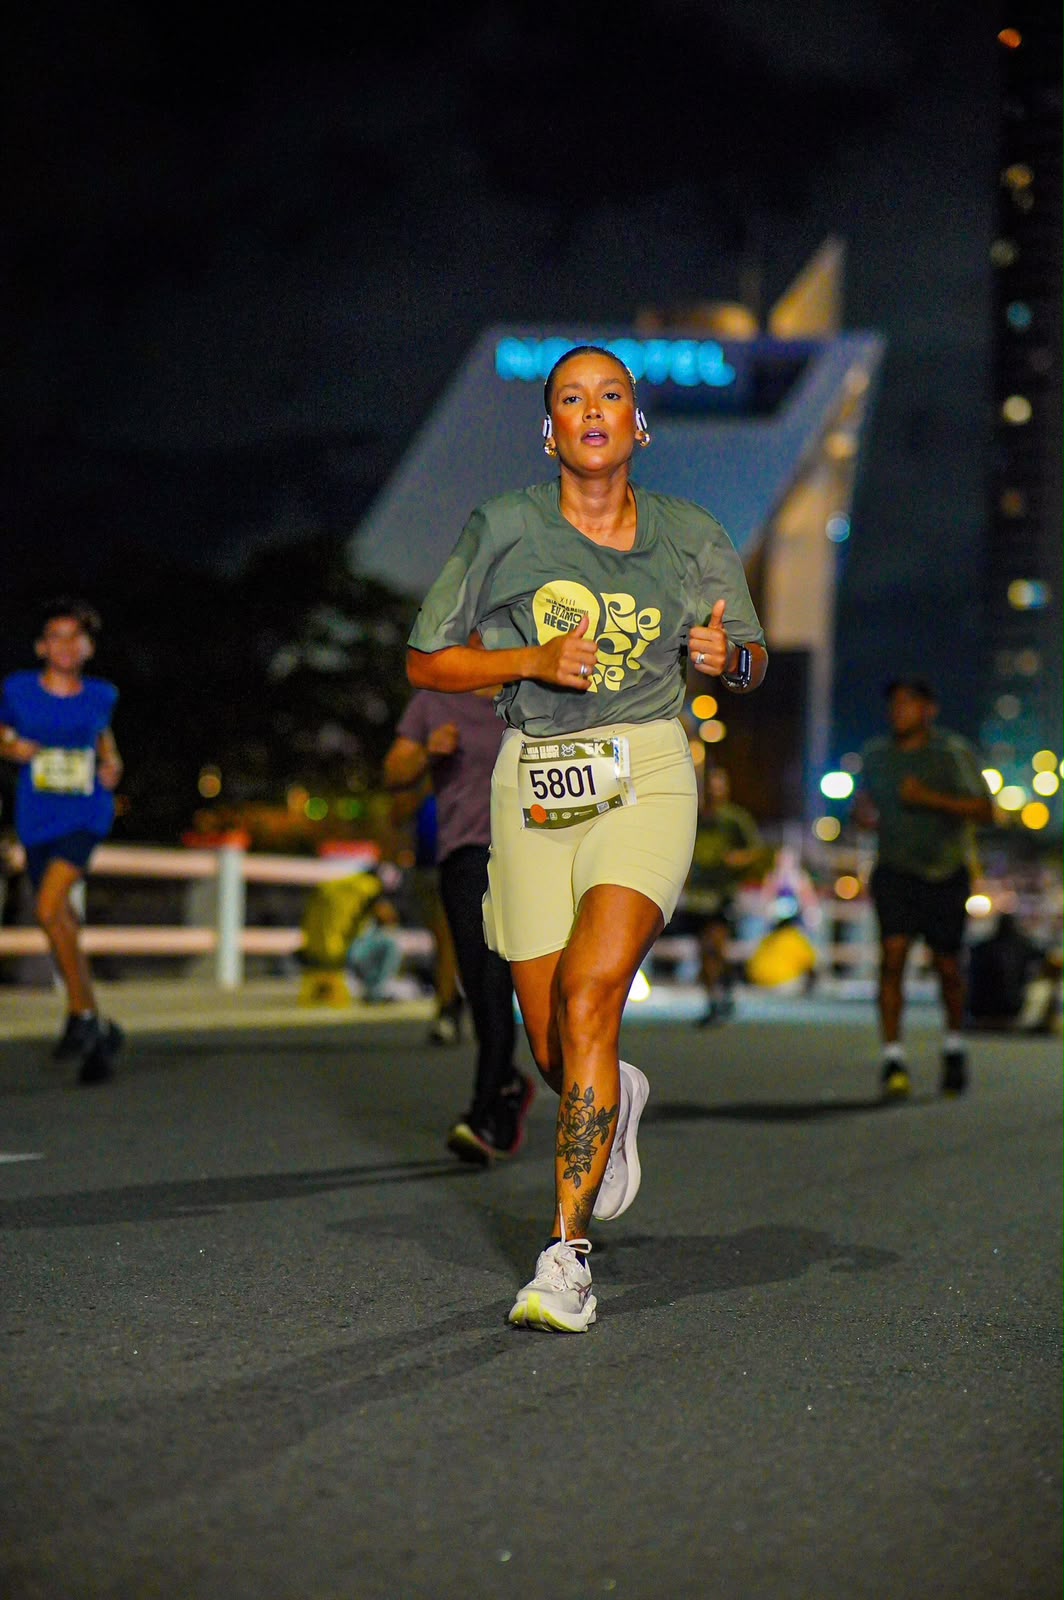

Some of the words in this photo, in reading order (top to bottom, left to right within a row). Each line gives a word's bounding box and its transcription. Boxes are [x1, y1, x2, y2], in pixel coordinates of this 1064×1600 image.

[551, 605, 561, 616] EU
[543, 612, 579, 633] RECI
[529, 765, 597, 800] 5801
